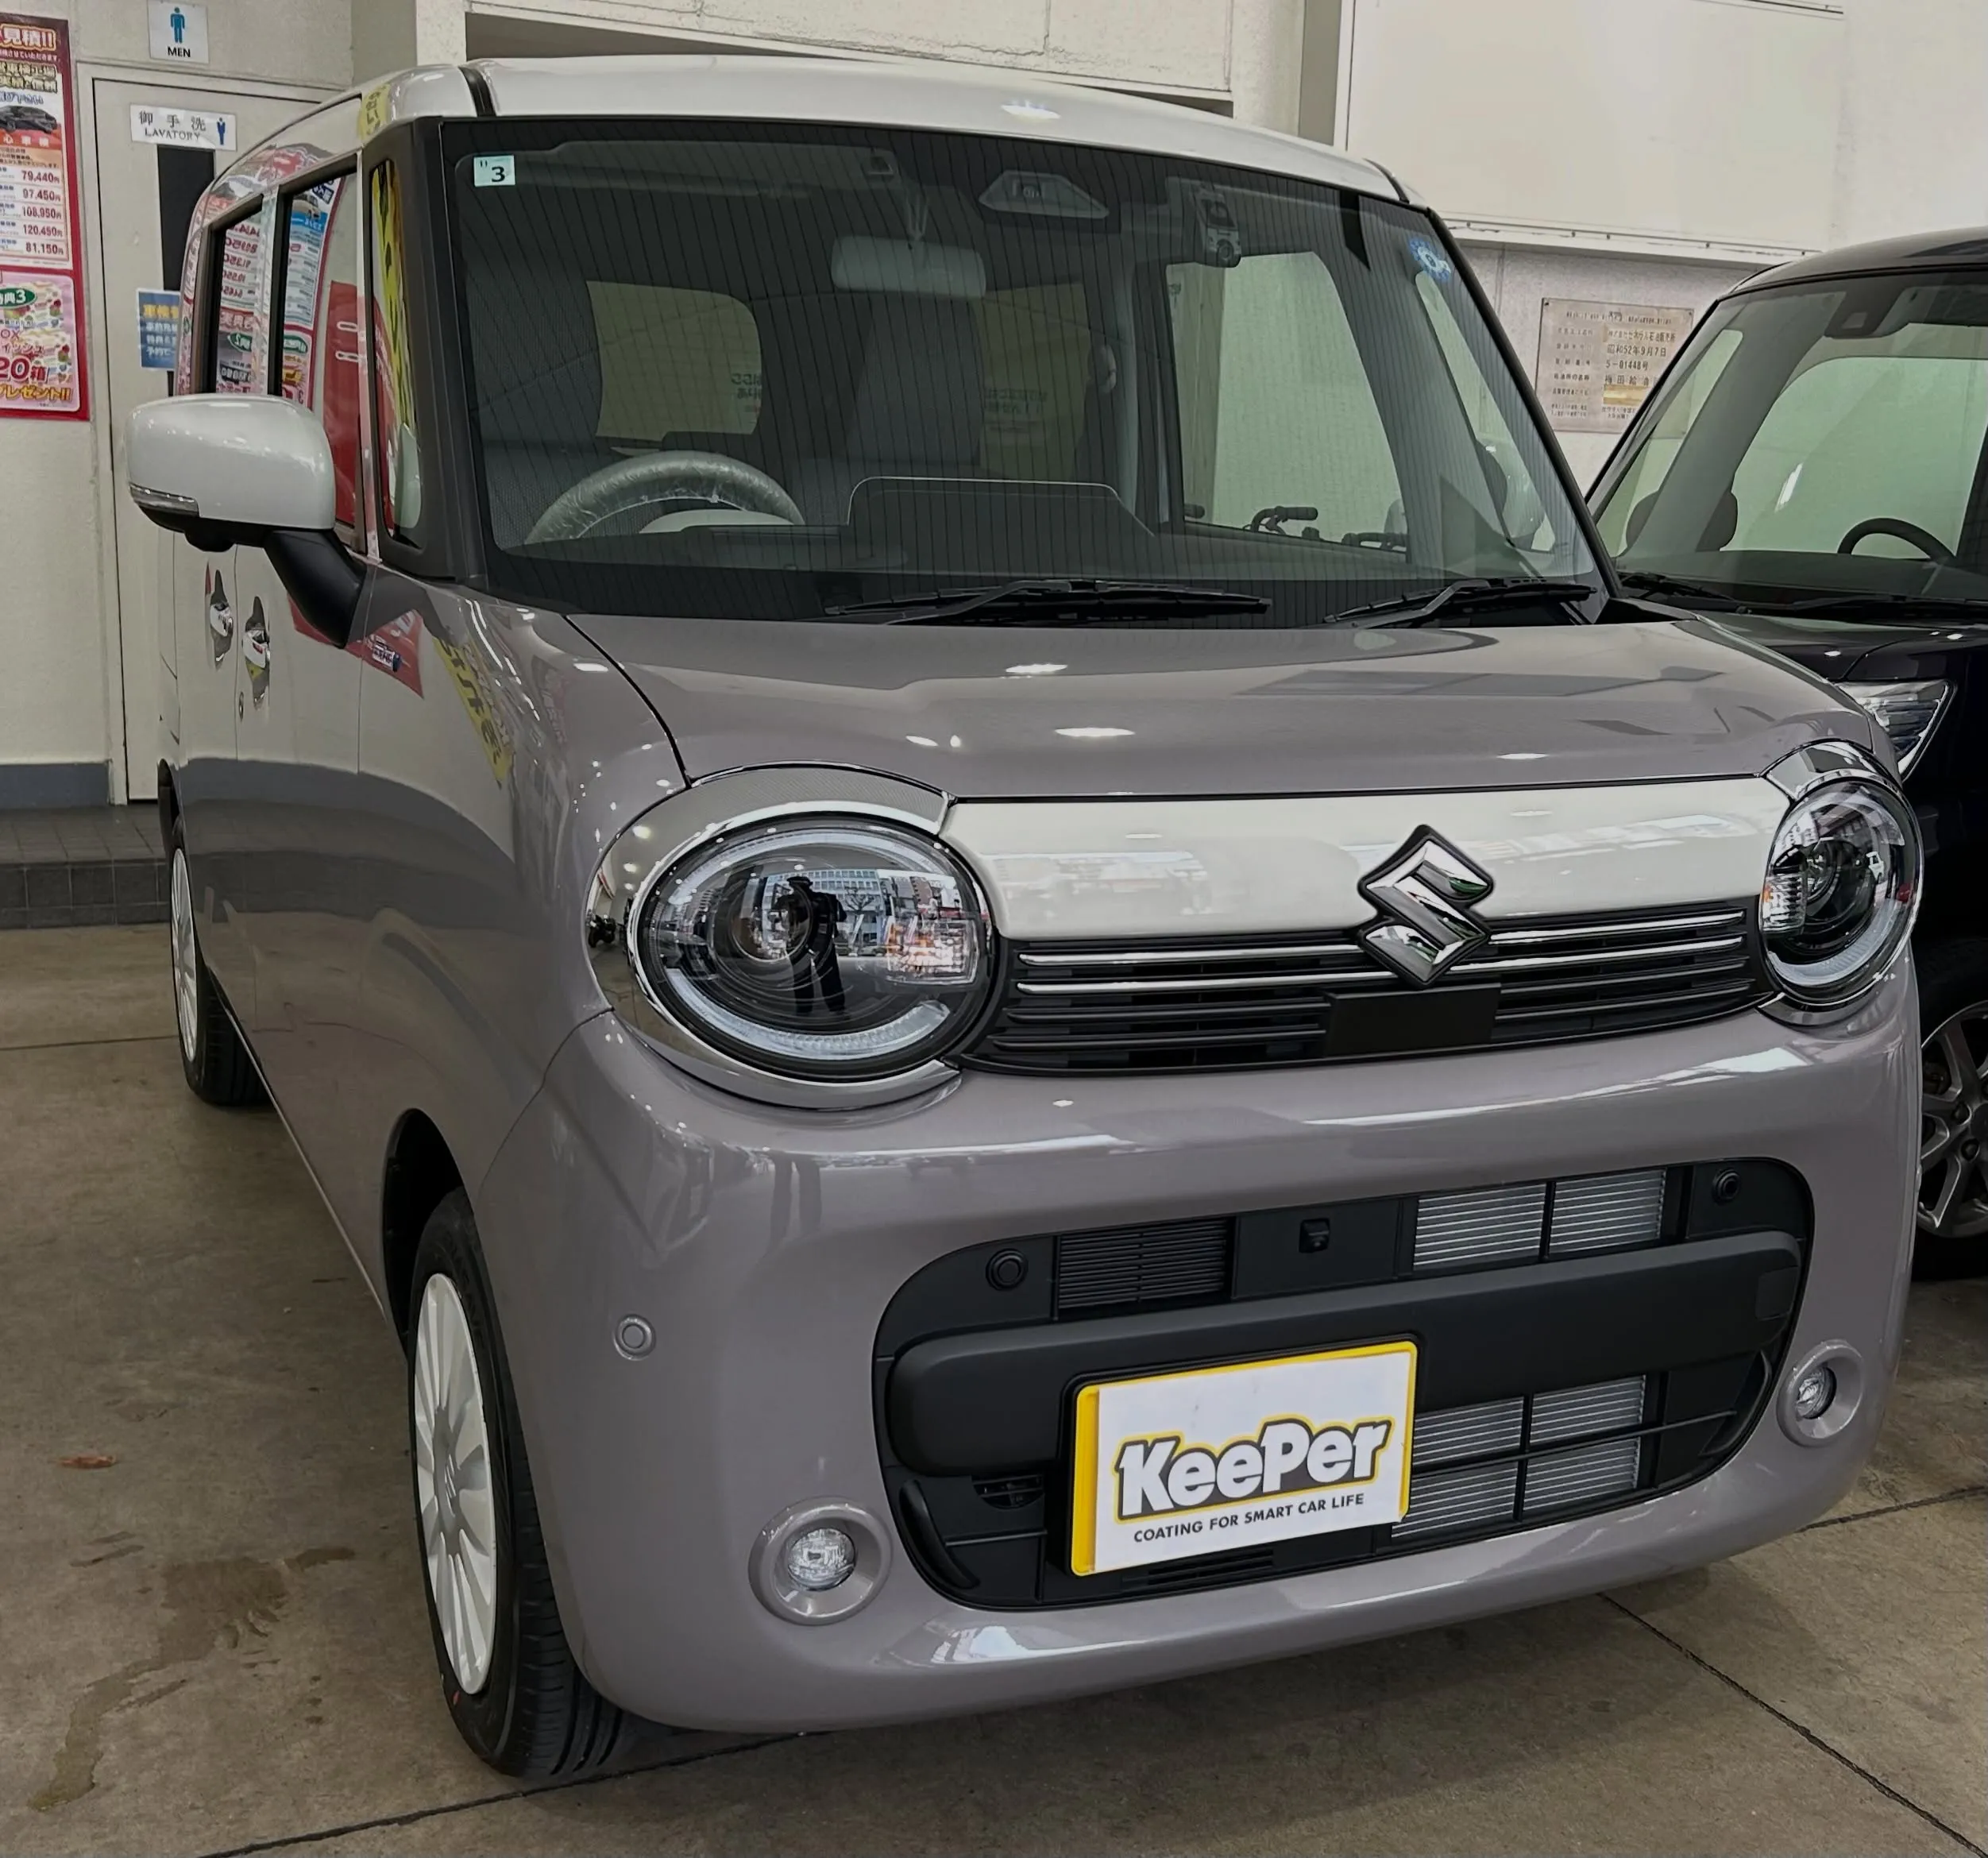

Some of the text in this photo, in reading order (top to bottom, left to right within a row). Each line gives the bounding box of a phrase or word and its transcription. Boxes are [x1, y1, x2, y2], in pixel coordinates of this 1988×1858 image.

[168, 46, 191, 57] MEN
[139, 110, 206, 131] 御手洗
[145, 127, 201, 141] LAVATORY
[491, 166, 505, 183] 3
[1116, 1418, 1392, 1520] KeePer
[1133, 1493, 1365, 1543] COATING FOR SMART CAR LIFE
